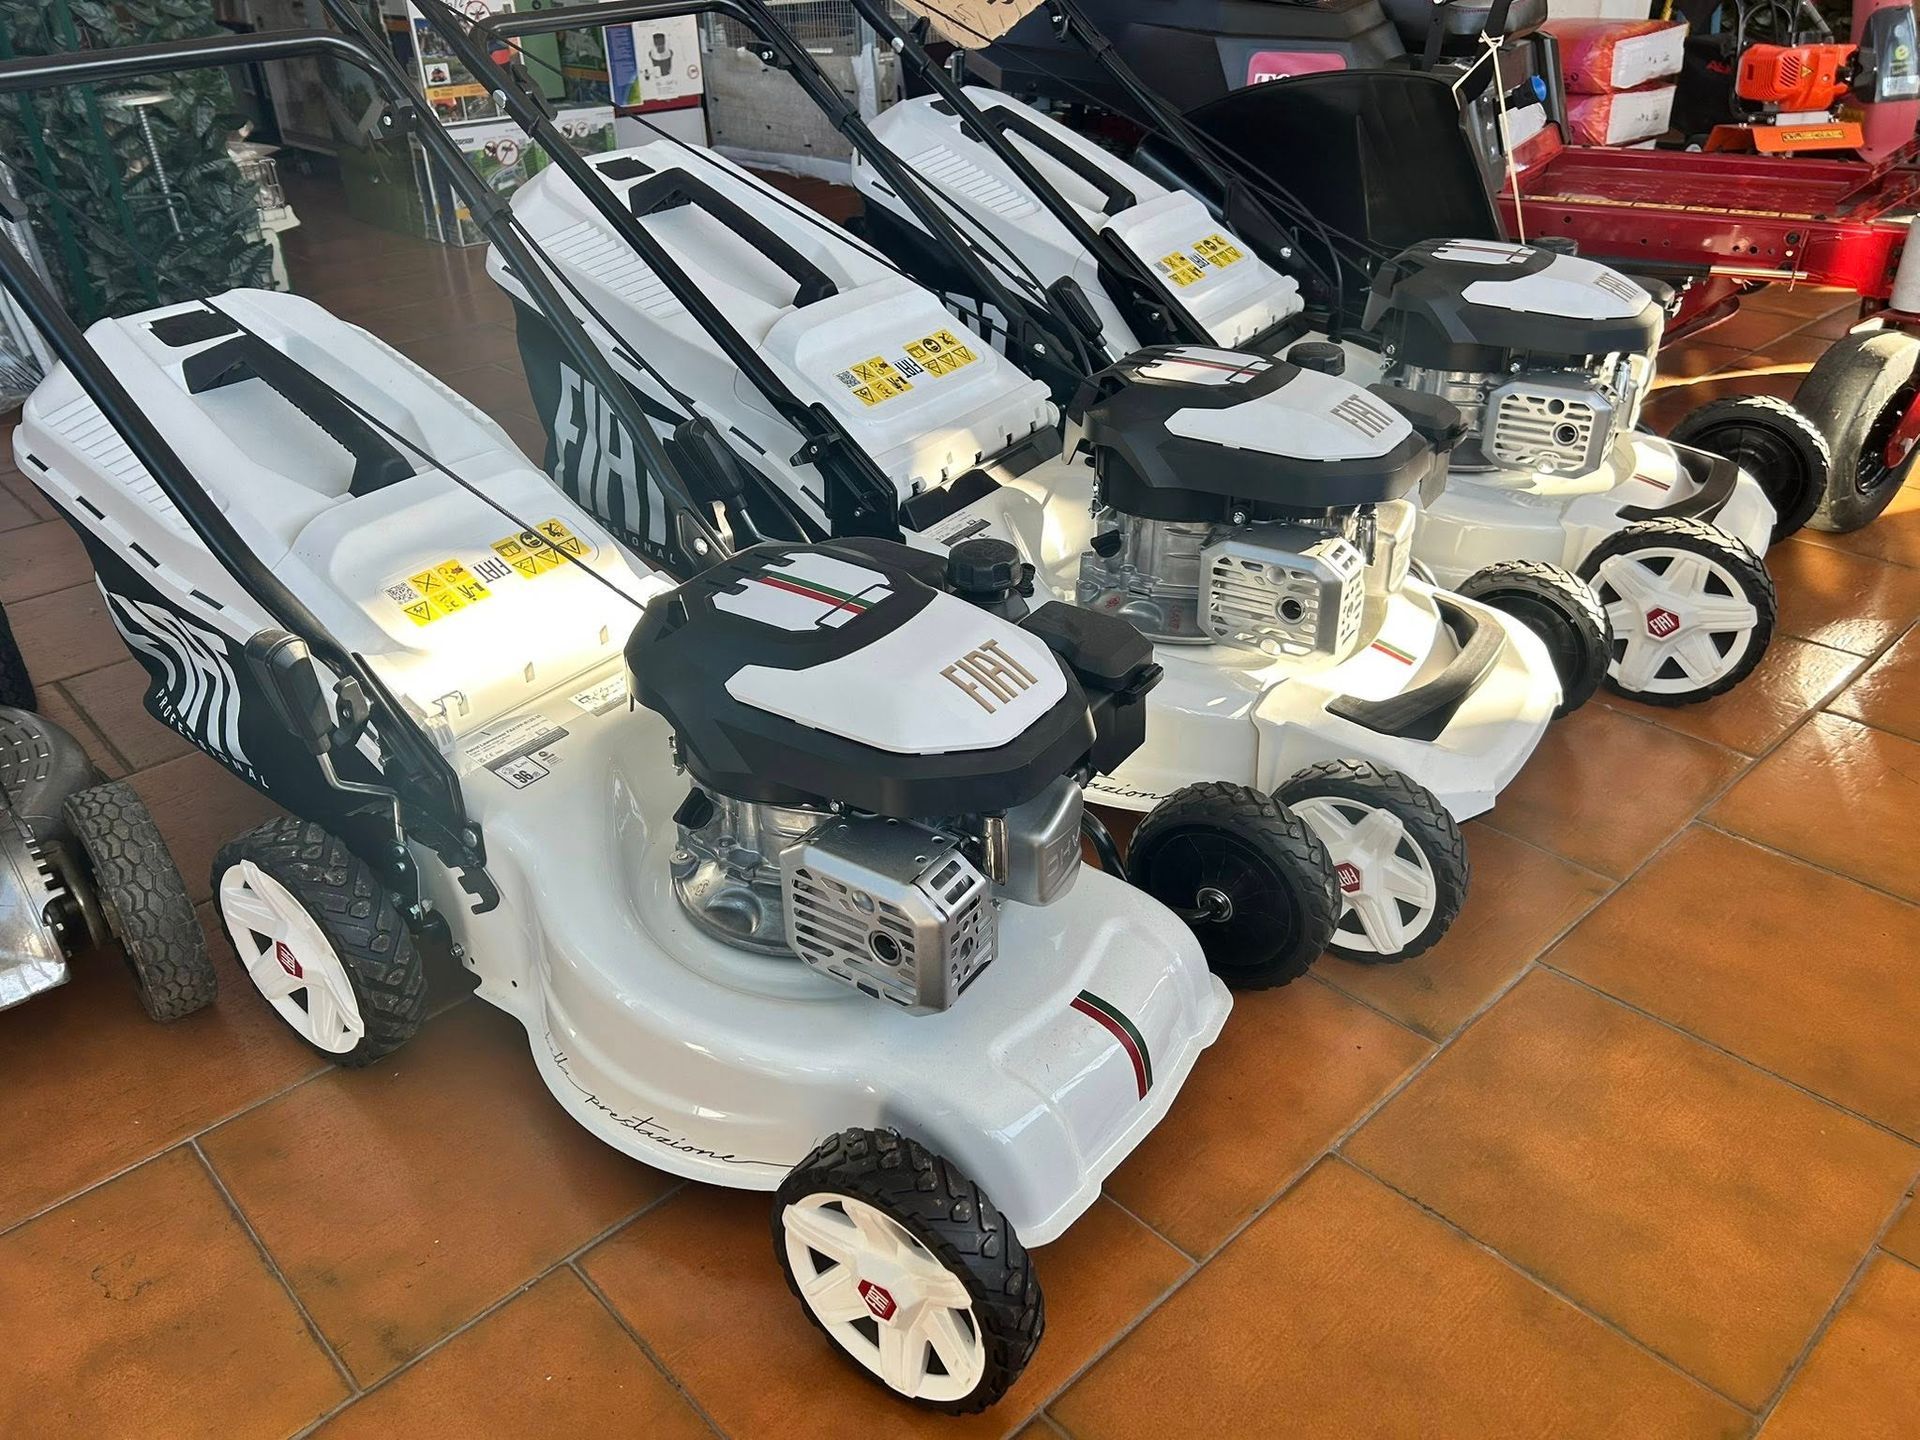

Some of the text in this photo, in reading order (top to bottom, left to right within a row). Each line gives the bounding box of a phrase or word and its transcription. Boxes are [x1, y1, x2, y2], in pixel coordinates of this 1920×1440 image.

[1593, 271, 1639, 304] FIAT
[893, 356, 925, 379] FIAT
[1328, 393, 1394, 439] FIAT
[472, 556, 513, 584] FIAT
[1649, 611, 1676, 635] FIAT
[95, 571, 254, 767] FIAT
[939, 638, 1039, 715] FIAT
[513, 770, 534, 784] 96
[279, 943, 296, 976] FIAT
[584, 1094, 760, 1165] prestazione
[865, 1284, 892, 1316] FIAT
